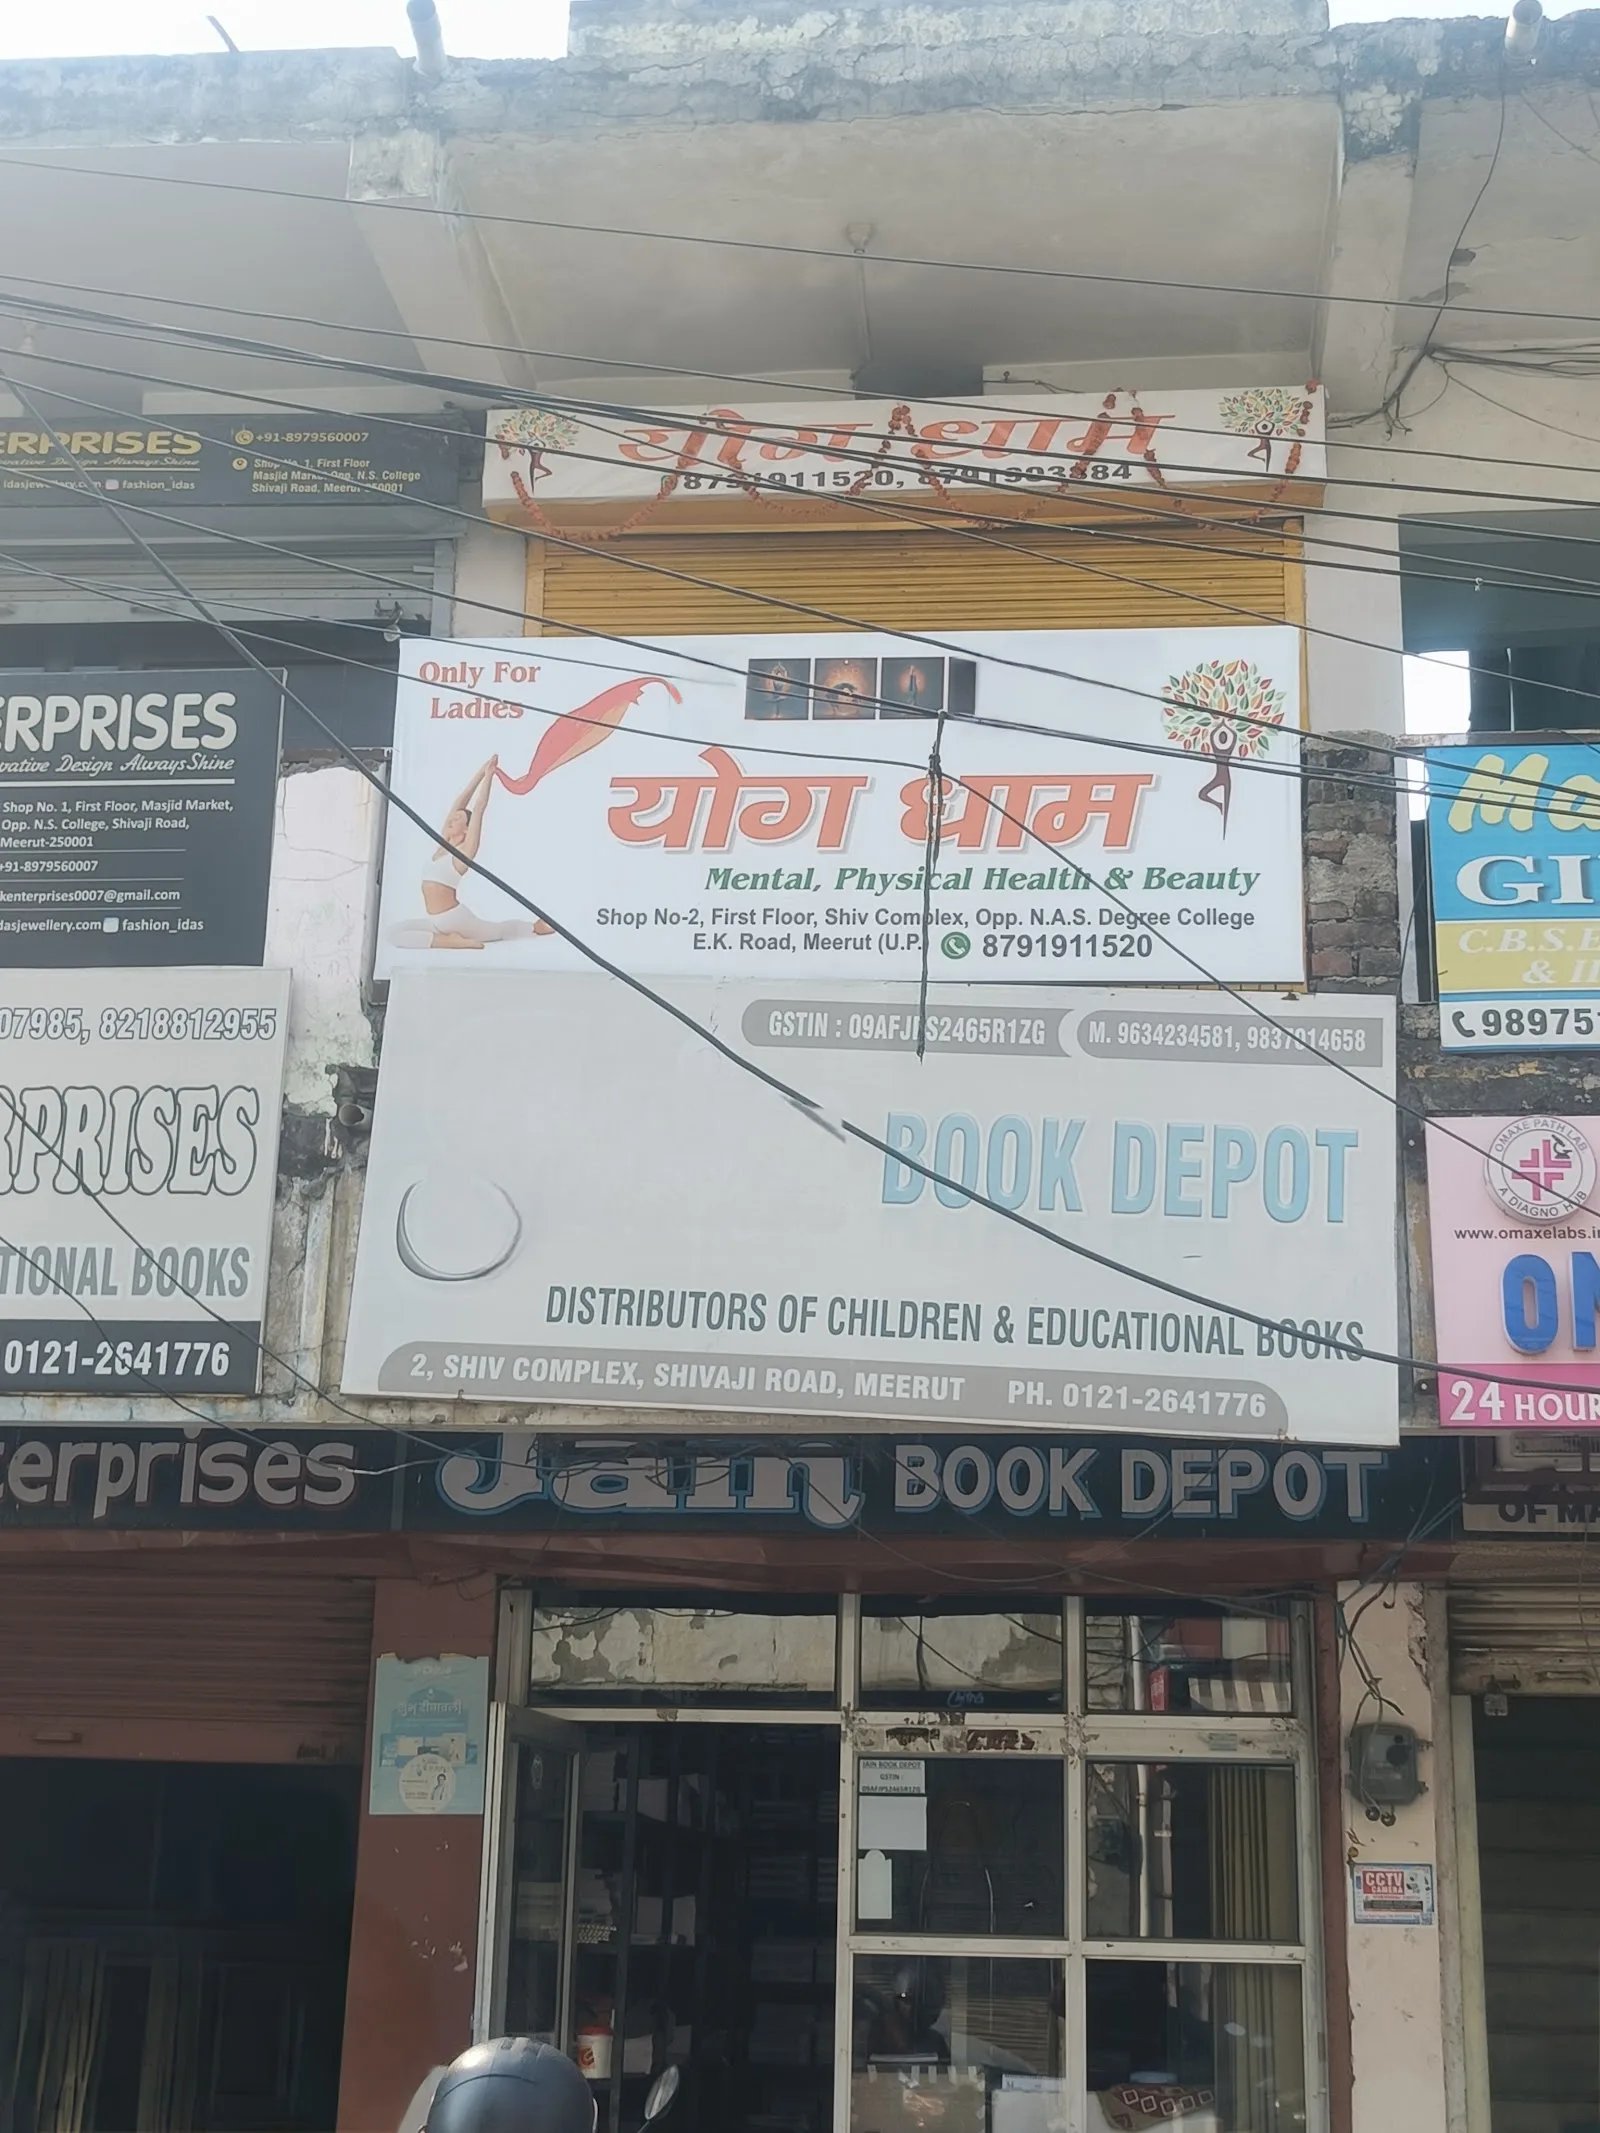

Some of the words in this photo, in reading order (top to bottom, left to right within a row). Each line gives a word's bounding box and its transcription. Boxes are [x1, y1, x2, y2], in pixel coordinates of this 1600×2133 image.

[256, 432, 369, 443] +91-8979560007
[253, 471, 288, 483] Masjid
[382, 471, 421, 482] College
[317, 459, 340, 468] First
[343, 459, 371, 468] Floor
[252, 482, 288, 495] Shivaji
[418, 661, 485, 688] Only
[493, 661, 541, 683] For
[430, 697, 525, 719] Ladies
[0, 692, 238, 752] RPRISES
[55, 753, 113, 777] Design
[2, 801, 34, 815] Shop
[36, 801, 58, 813] No.
[61, 801, 72, 814] 1,
[75, 801, 101, 812] First
[104, 800, 138, 813] Floor,
[141, 800, 182, 815] Masjid
[185, 799, 234, 813] Market,
[607, 744, 869, 849] योग
[899, 773, 1154, 848] धाम
[2, 819, 31, 832] Opp.
[34, 819, 58, 831] N.S.
[61, 818, 110, 832] College,
[112, 818, 152, 832] Shivaji
[155, 817, 190, 830] Road,
[0, 836, 94, 848] Meerut-250001
[705, 867, 821, 893] Mental,
[834, 866, 973, 897] Physical
[983, 866, 1093, 892] Health
[1104, 866, 1133, 891] &
[1142, 867, 1261, 897] Beauty
[1456, 855, 1600, 905] GI
[122, 917, 204, 933] fashion_idas
[596, 908, 648, 930] Shop
[654, 908, 705, 928] No-2,
[712, 907, 756, 926] First
[762, 907, 817, 928] Floor,
[825, 907, 868, 926] Shiv
[976, 908, 1022, 930] Opp.
[1030, 908, 1091, 926] N.A.S.
[1099, 908, 1170, 930] Degree
[1178, 908, 1255, 930] College
[694, 933, 732, 950] E.K.
[740, 933, 796, 953] Road,
[803, 933, 872, 951] Meerut
[983, 934, 1152, 957] 8791911520
[1522, 959, 1557, 985] &
[99, 1007, 277, 1041] 8218812955
[769, 1011, 829, 1038] GSTIN
[1482, 1008, 1600, 1037] 98975
[1089, 1021, 1111, 1043] M.
[1118, 1021, 1241, 1052] 9634234581,
[1495, 1120, 1530, 1152] OMAXE
[1533, 1119, 1567, 1133] PATH
[1566, 1130, 1588, 1153] LAB
[881, 1111, 1087, 1213] BOOK
[1111, 1119, 1360, 1224] DEPOT
[1498, 1187, 1509, 1196] A
[1508, 1196, 1559, 1217] DIAGNO
[1563, 1190, 1588, 1212] HUB
[1454, 1226, 1600, 1240] www.omaxelabs.i
[131, 1247, 250, 1298] BOOKS
[546, 1286, 767, 1332] DISTRIBUTORS
[778, 1295, 818, 1333] OF
[827, 1296, 982, 1342] CHILDREN
[993, 1305, 1014, 1344] &
[1027, 1306, 1244, 1356] EDUCATIONAL
[1256, 1318, 1365, 1362] BOOKS
[4, 1340, 230, 1376] 0121-2641776
[410, 1353, 434, 1381] 2,
[443, 1353, 506, 1380] SHIV
[512, 1356, 645, 1391] COMPLEX,
[654, 1362, 756, 1391] SHIVAJI
[765, 1367, 844, 1399] ROAD,
[854, 1372, 966, 1401] MEERUT
[1008, 1380, 1053, 1405] PH.
[1063, 1383, 1267, 1418] 0121-2641776
[1450, 1381, 1505, 1422] 24
[0, 1425, 357, 1520] erprises
[436, 1432, 864, 1528] Jain
[894, 1445, 1100, 1518] BOOK
[1120, 1448, 1389, 1522] DEPOT
[1365, 1872, 1403, 1886] CCTV
[1371, 1886, 1404, 1894] CAMERA
